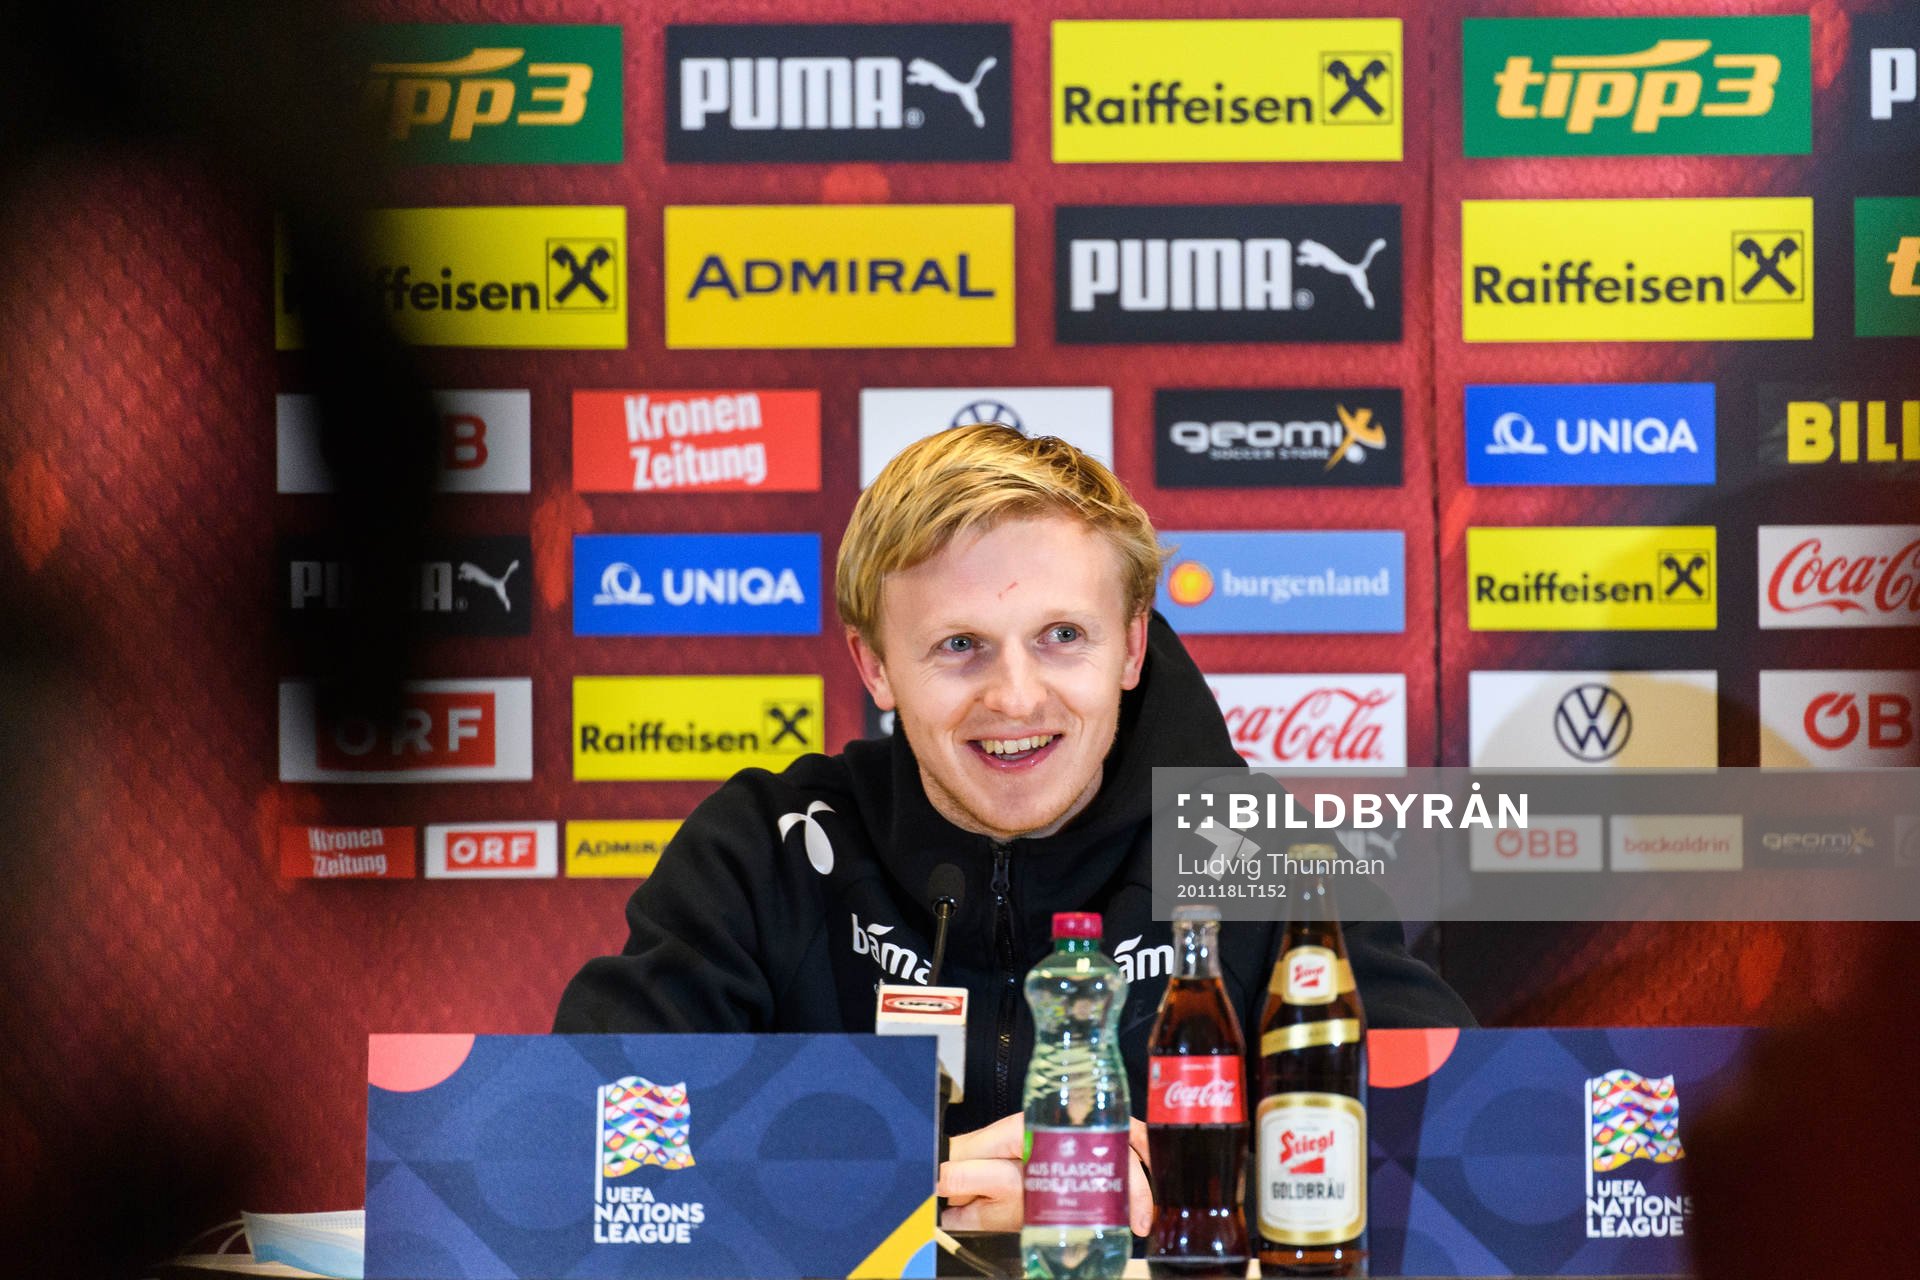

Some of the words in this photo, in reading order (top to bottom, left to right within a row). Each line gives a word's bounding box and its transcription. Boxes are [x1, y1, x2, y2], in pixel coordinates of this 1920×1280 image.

[367, 47, 595, 141] pp3
[680, 57, 902, 130] PUMA
[1063, 82, 1313, 125] Raiffeisen
[1494, 39, 1781, 133] tipp3
[376, 266, 541, 312] feisen
[687, 253, 995, 299] ADMIRAL
[1070, 238, 1292, 311] PUMA
[1473, 261, 1725, 304] Raiffeisen
[624, 394, 762, 441] Kronen
[1556, 418, 1698, 455] UNIQA
[630, 443, 768, 490] Zeitung
[290, 561, 452, 611] PA
[662, 568, 804, 605] UNIQA
[1223, 567, 1389, 602] burgenland
[1476, 572, 1654, 604] Raiffeisen
[580, 722, 759, 754] Raiffeisen
[1216, 688, 1396, 762] ca-Cola
[1804, 692, 1920, 750] ÖB
[308, 827, 383, 852] Kronen
[452, 837, 530, 864] ORF
[575, 839, 669, 858] ADMIR
[1494, 829, 1579, 859] ÖBB
[312, 853, 387, 877] Zeitung
[1114, 936, 1175, 985] am
[1280, 1129, 1335, 1164] Stiegl
[606, 1187, 654, 1204] UEFA
[1272, 1180, 1345, 1201] GOLDBRÄU
[1597, 1180, 1646, 1197] UEFA
[594, 1202, 705, 1224] NATIONS
[1586, 1216, 1684, 1238] LEAGUE
[594, 1223, 691, 1243] LEAGUE
